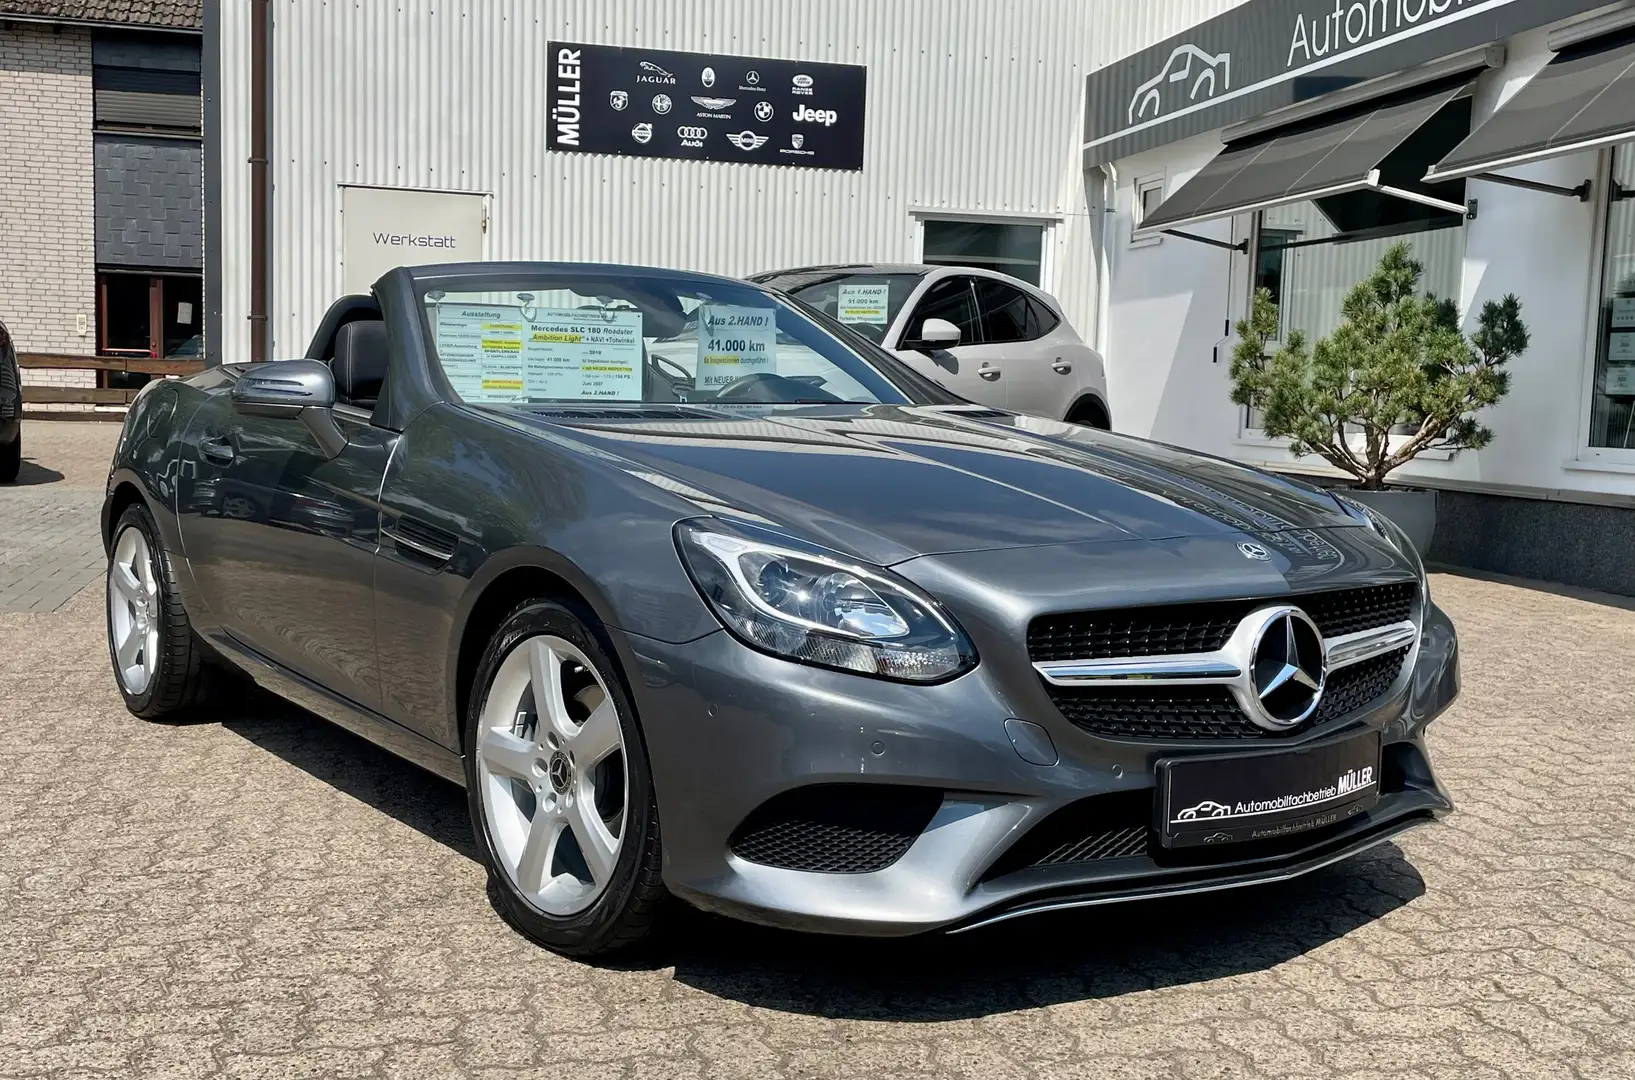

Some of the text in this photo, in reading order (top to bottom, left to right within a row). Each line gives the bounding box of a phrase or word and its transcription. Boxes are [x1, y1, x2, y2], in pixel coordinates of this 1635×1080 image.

[636, 75, 676, 85] JAGUAR
[552, 48, 581, 146] MÜLLER
[792, 104, 837, 127] Jeep
[681, 139, 703, 148] Audi
[372, 232, 456, 248] Werkstatt
[461, 311, 501, 319] Ausstattung
[708, 315, 726, 326] Aus
[728, 316, 763, 326] 2.HAND
[531, 325, 568, 333] Mercedes
[708, 339, 765, 351] 41.000 km
[710, 356, 739, 364] Inspektionen
[1234, 766, 1373, 814] Automobilfachbetrieb MÜLLER
[1315, 814, 1337, 828] MÜLLER
